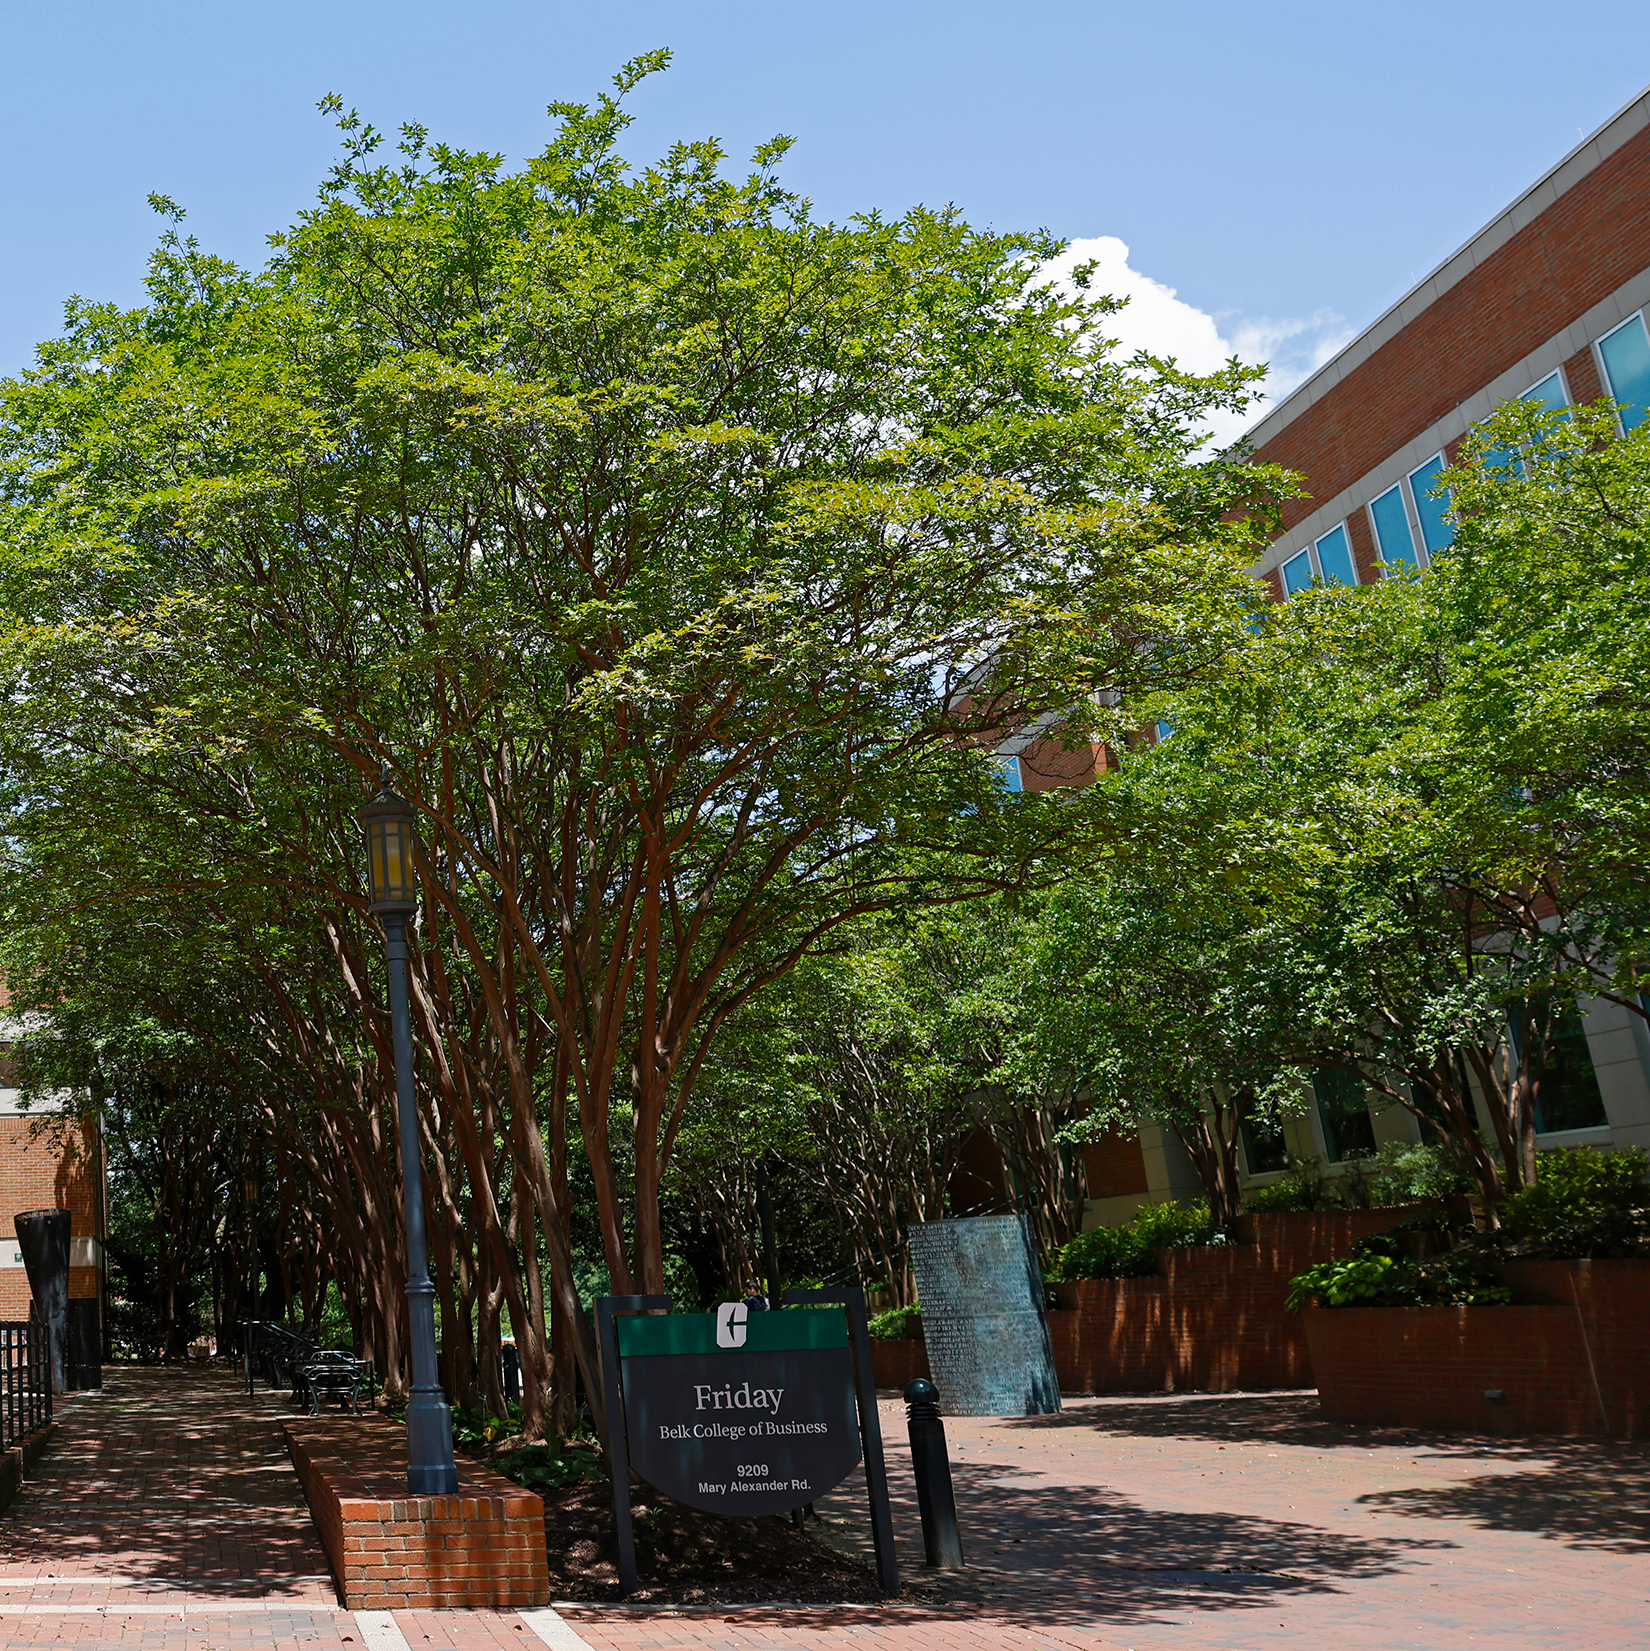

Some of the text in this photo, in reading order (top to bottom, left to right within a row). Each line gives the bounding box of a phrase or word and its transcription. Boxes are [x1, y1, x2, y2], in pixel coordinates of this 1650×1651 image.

[693, 1382, 784, 1415] Friday
[659, 1421, 828, 1440] Belk College of Business
[737, 1464, 769, 1477] 9209
[698, 1479, 811, 1495] Mary Alexander Rd.
